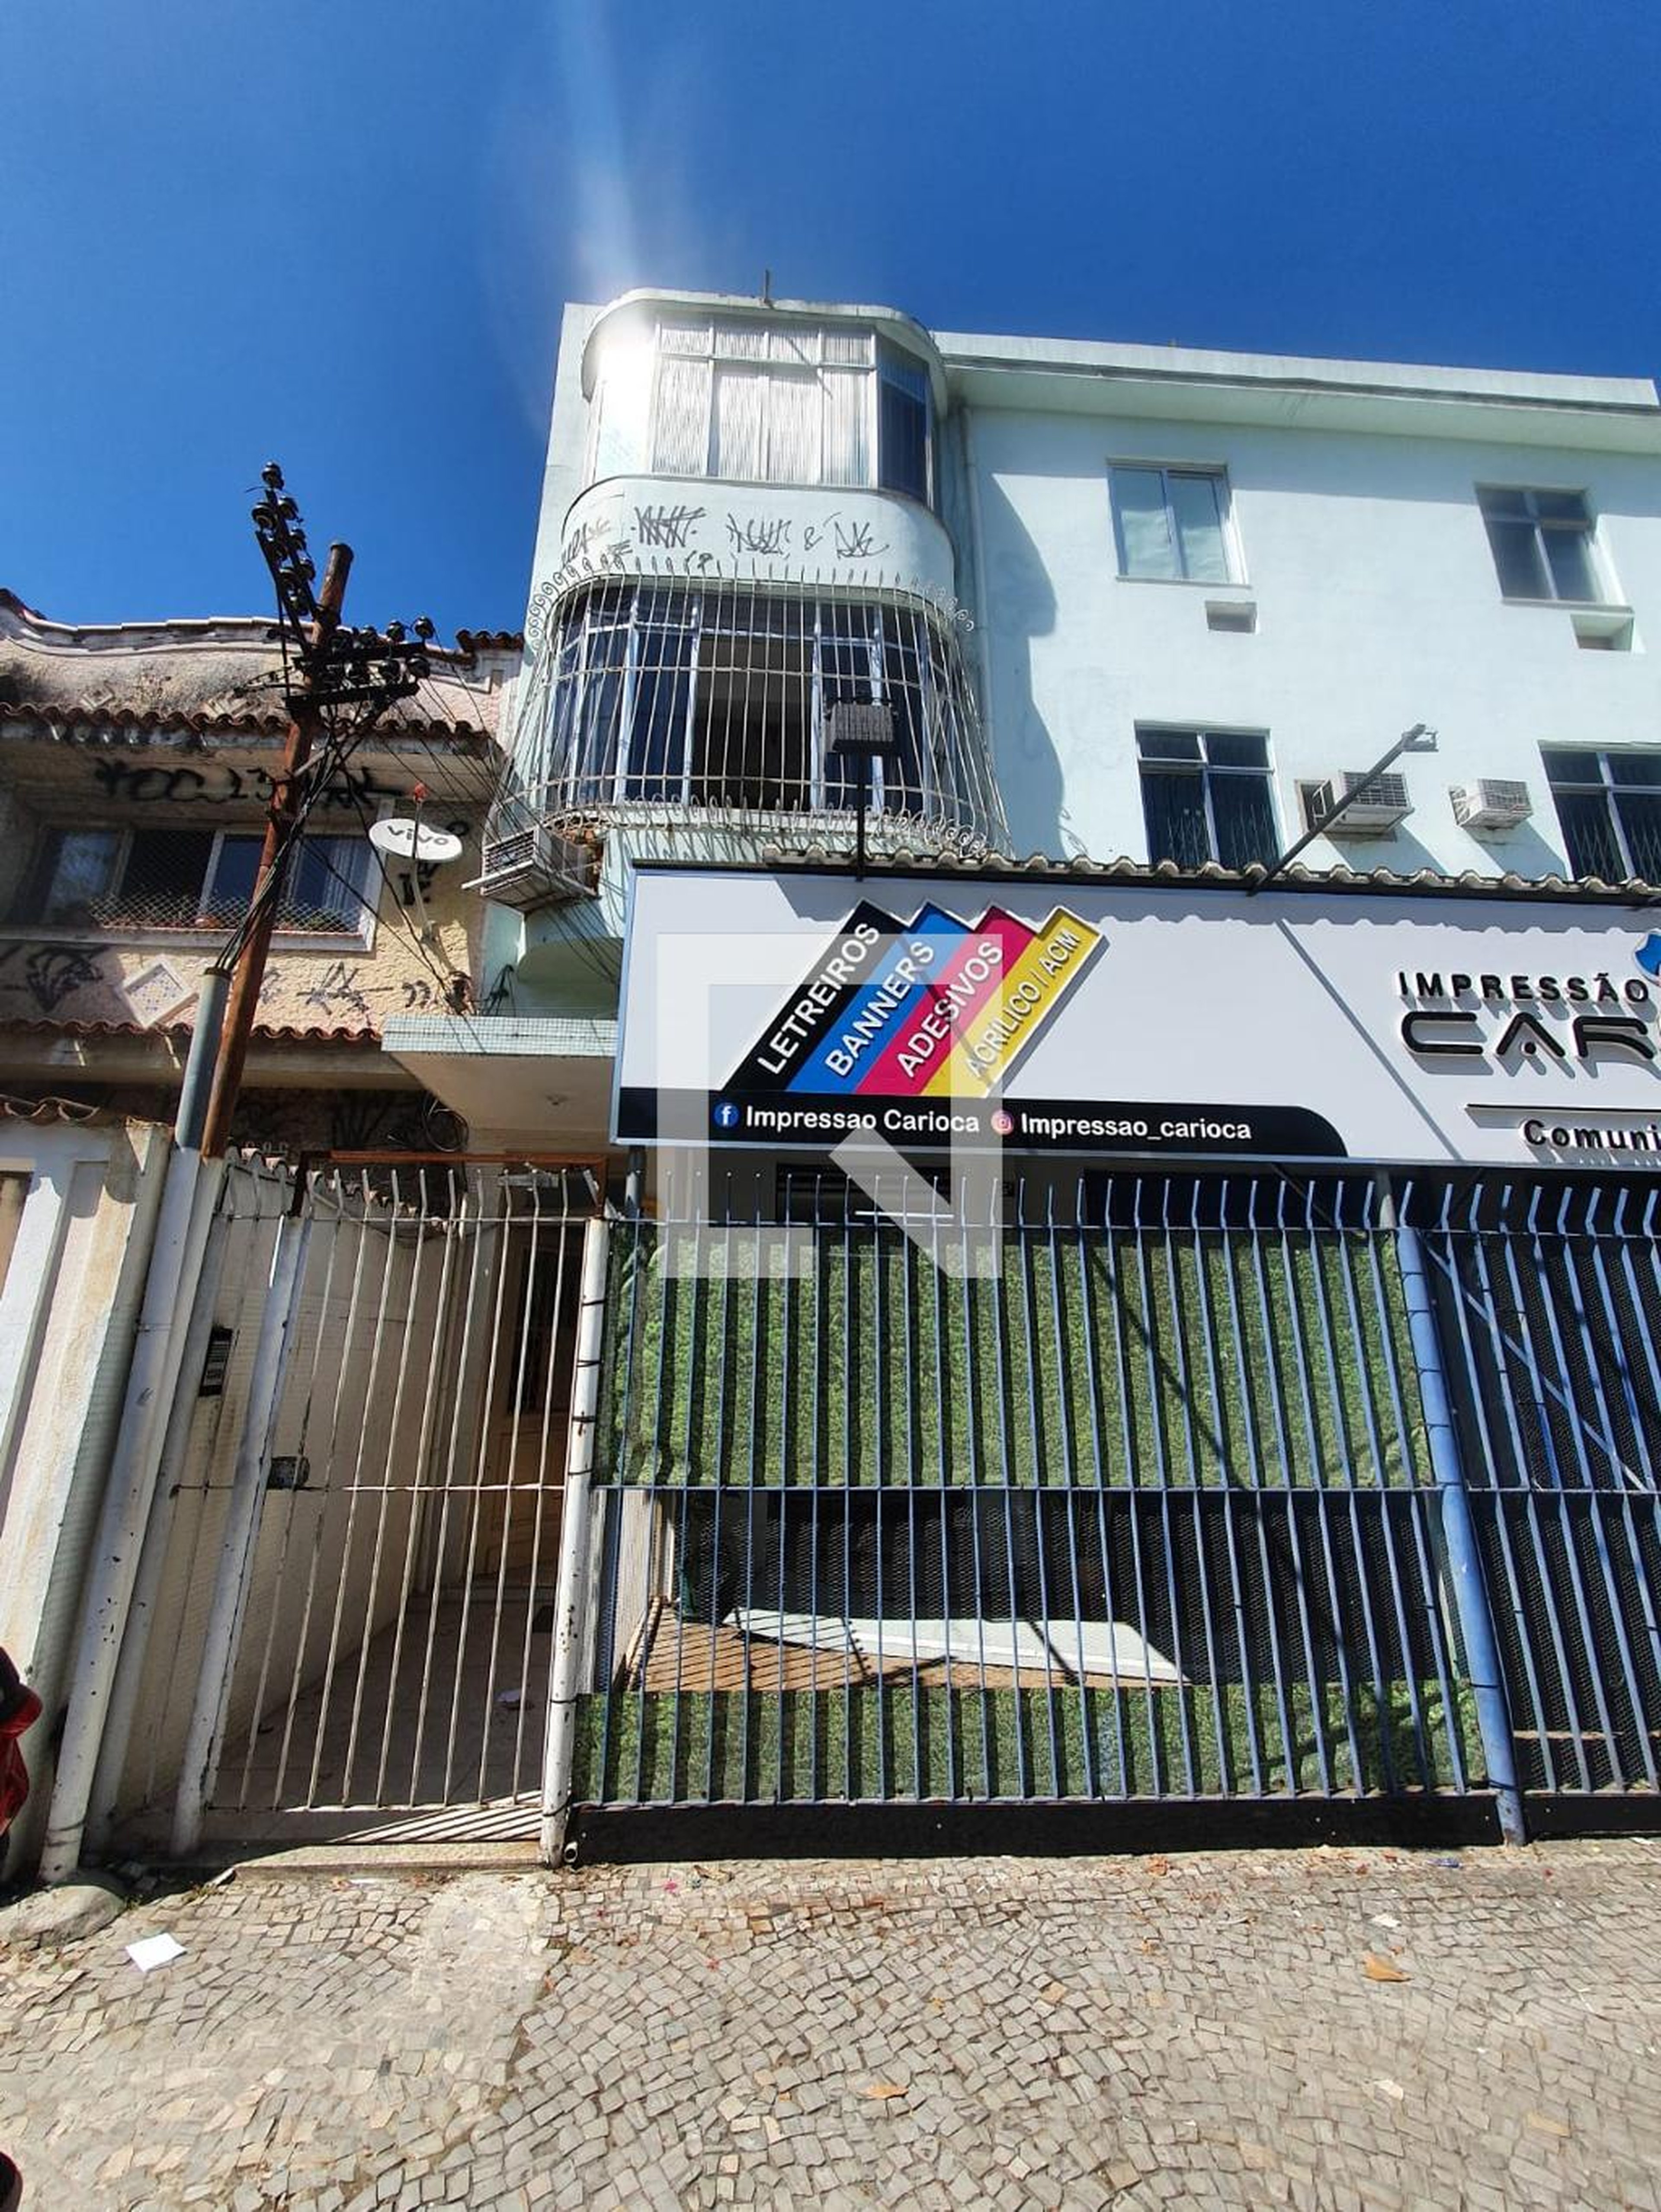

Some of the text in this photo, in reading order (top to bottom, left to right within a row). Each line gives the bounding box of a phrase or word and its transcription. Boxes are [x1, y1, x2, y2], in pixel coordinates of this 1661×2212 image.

[387, 825, 449, 845] vivo
[1038, 930, 1081, 977] ACM
[757, 923, 880, 1074] LETREIROS
[1398, 972, 1649, 1002] IMPRESSÃO
[824, 941, 934, 1076] BANNERS
[897, 941, 1003, 1078] ADESIVOS
[1401, 1011, 1655, 1060] CAR
[747, 1105, 980, 1133] Impressao Carioca
[1021, 1113, 1252, 1140] Impressao_carioca
[1524, 1119, 1661, 1150] Comuni
